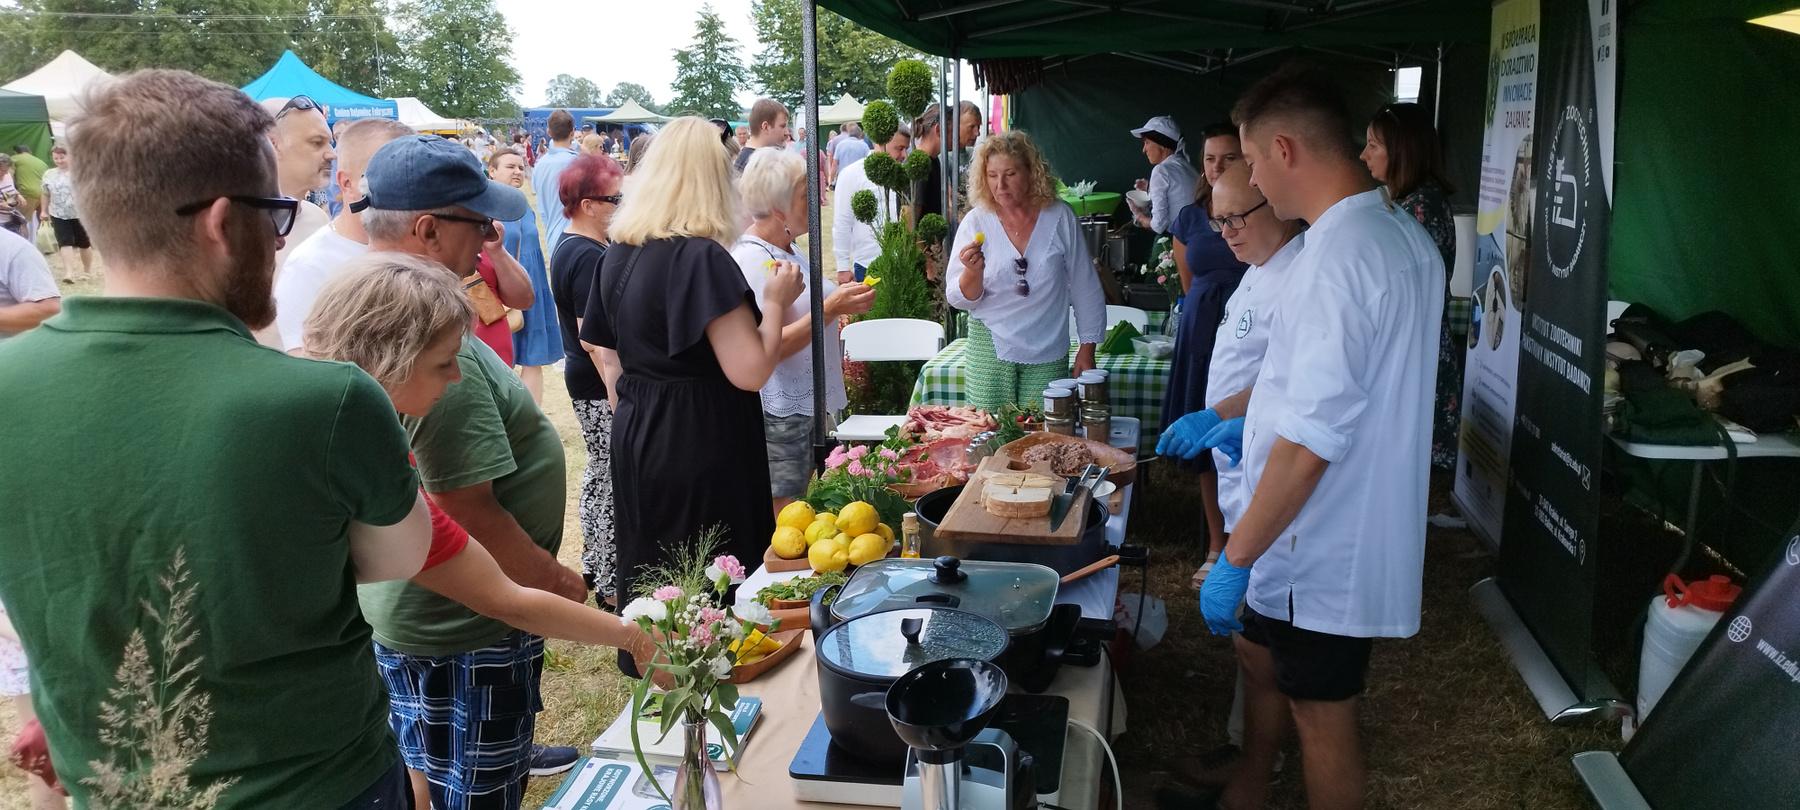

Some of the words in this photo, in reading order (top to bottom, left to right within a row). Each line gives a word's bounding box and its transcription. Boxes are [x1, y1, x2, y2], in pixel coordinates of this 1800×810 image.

[1501, 24, 1536, 50] WSPÓŁPRACA
[1501, 54, 1535, 76] DORADZTWO
[1503, 83, 1532, 103] INNOWACJE
[1505, 111, 1530, 129] ZAUFANIE
[1566, 105, 1590, 187] ZOOTECHNIKI
[1550, 324, 1582, 358] ZOOTECHNIKI
[1543, 348, 1567, 377] INSTYTUT
[1566, 362, 1591, 396] BADAWCZY
[1756, 639, 1800, 683] www.iz.edu.p
